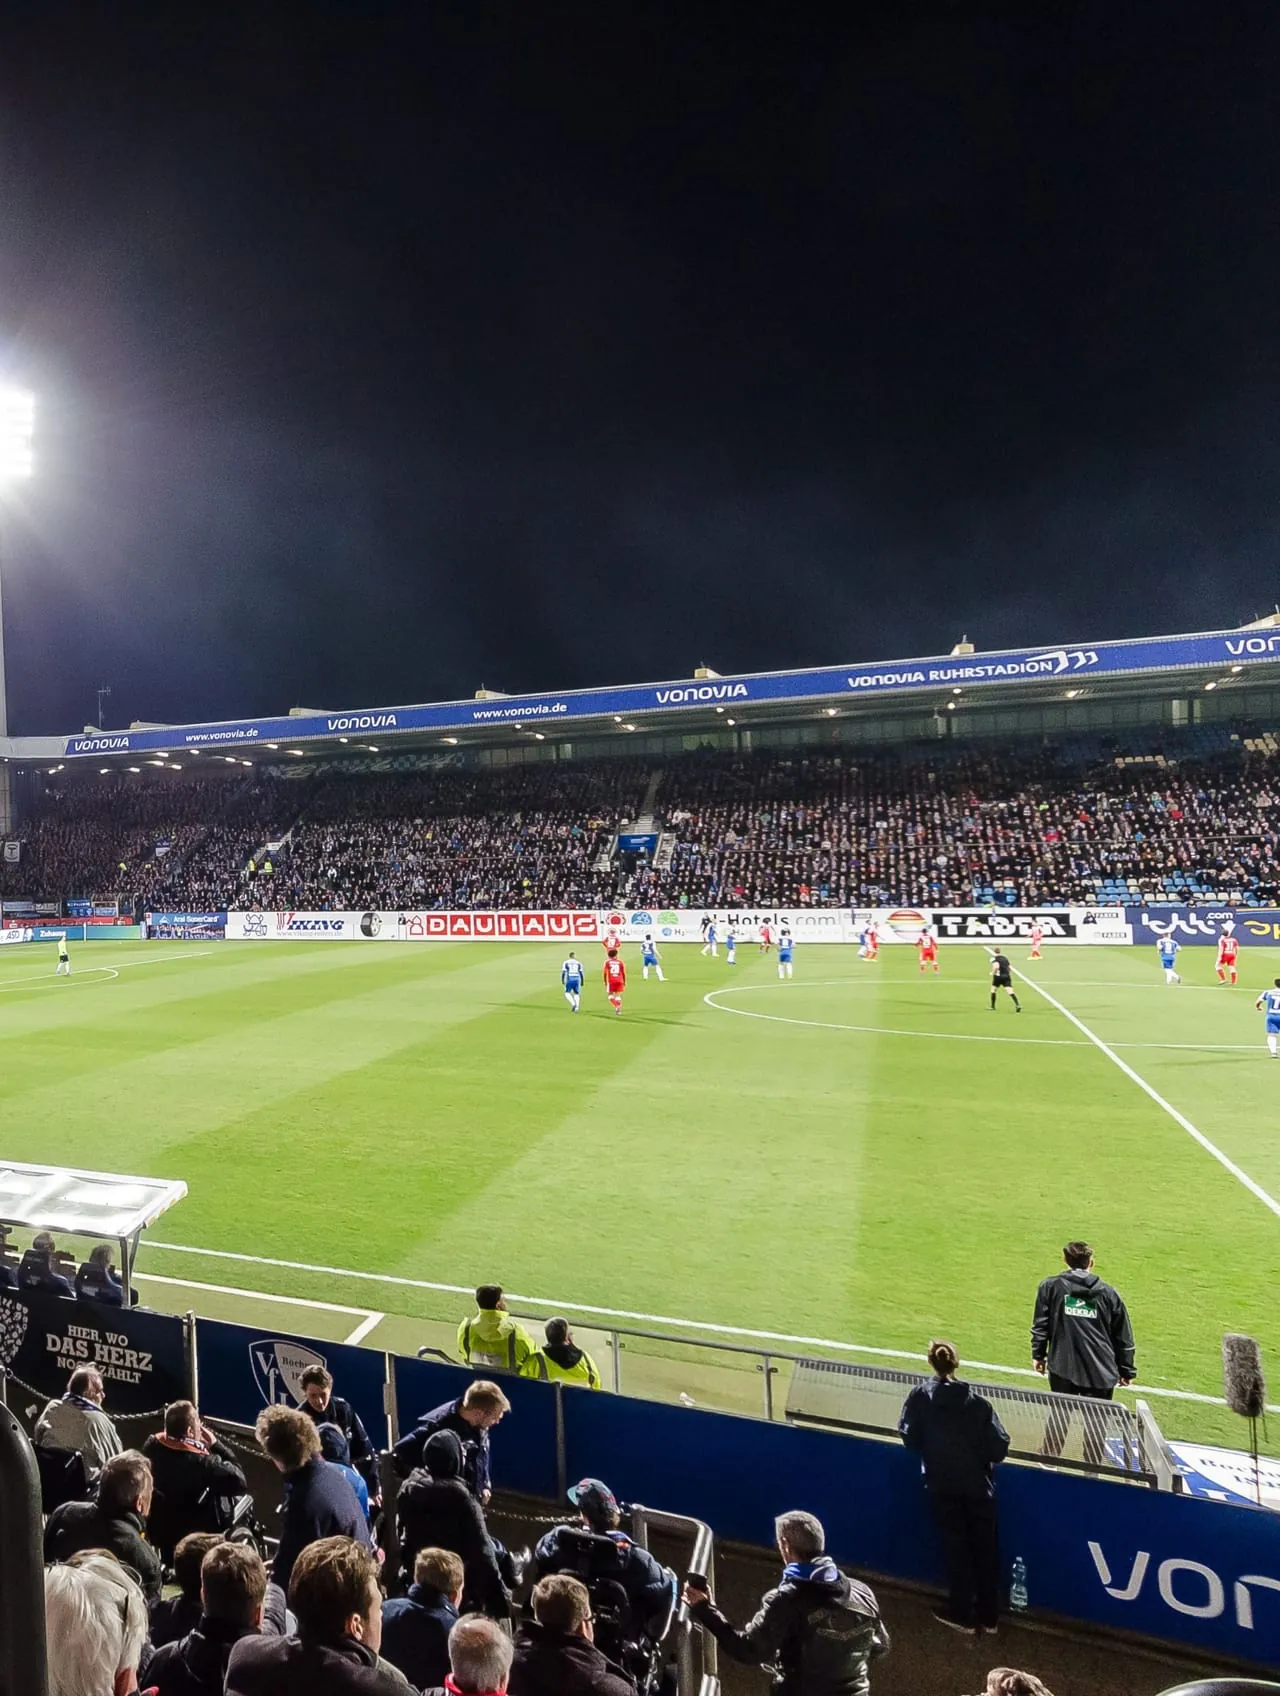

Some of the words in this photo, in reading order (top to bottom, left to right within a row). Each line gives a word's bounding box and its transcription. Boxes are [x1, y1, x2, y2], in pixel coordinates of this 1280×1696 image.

[847, 671, 926, 688] VONOVIA
[929, 660, 1054, 682] RUHRSTADION
[656, 683, 749, 704] VONOVIA
[473, 702, 568, 720] www.vonovia.de
[327, 714, 397, 730] VONOVIA
[74, 737, 129, 751] VONOVIA
[185, 727, 259, 742] www.vonovia.de
[67, 1324, 102, 1343] HIER,
[105, 1331, 129, 1347] WO
[46, 1333, 89, 1359] DAS
[94, 1342, 153, 1372] HERZ
[99, 1362, 142, 1384] ZÄHLT
